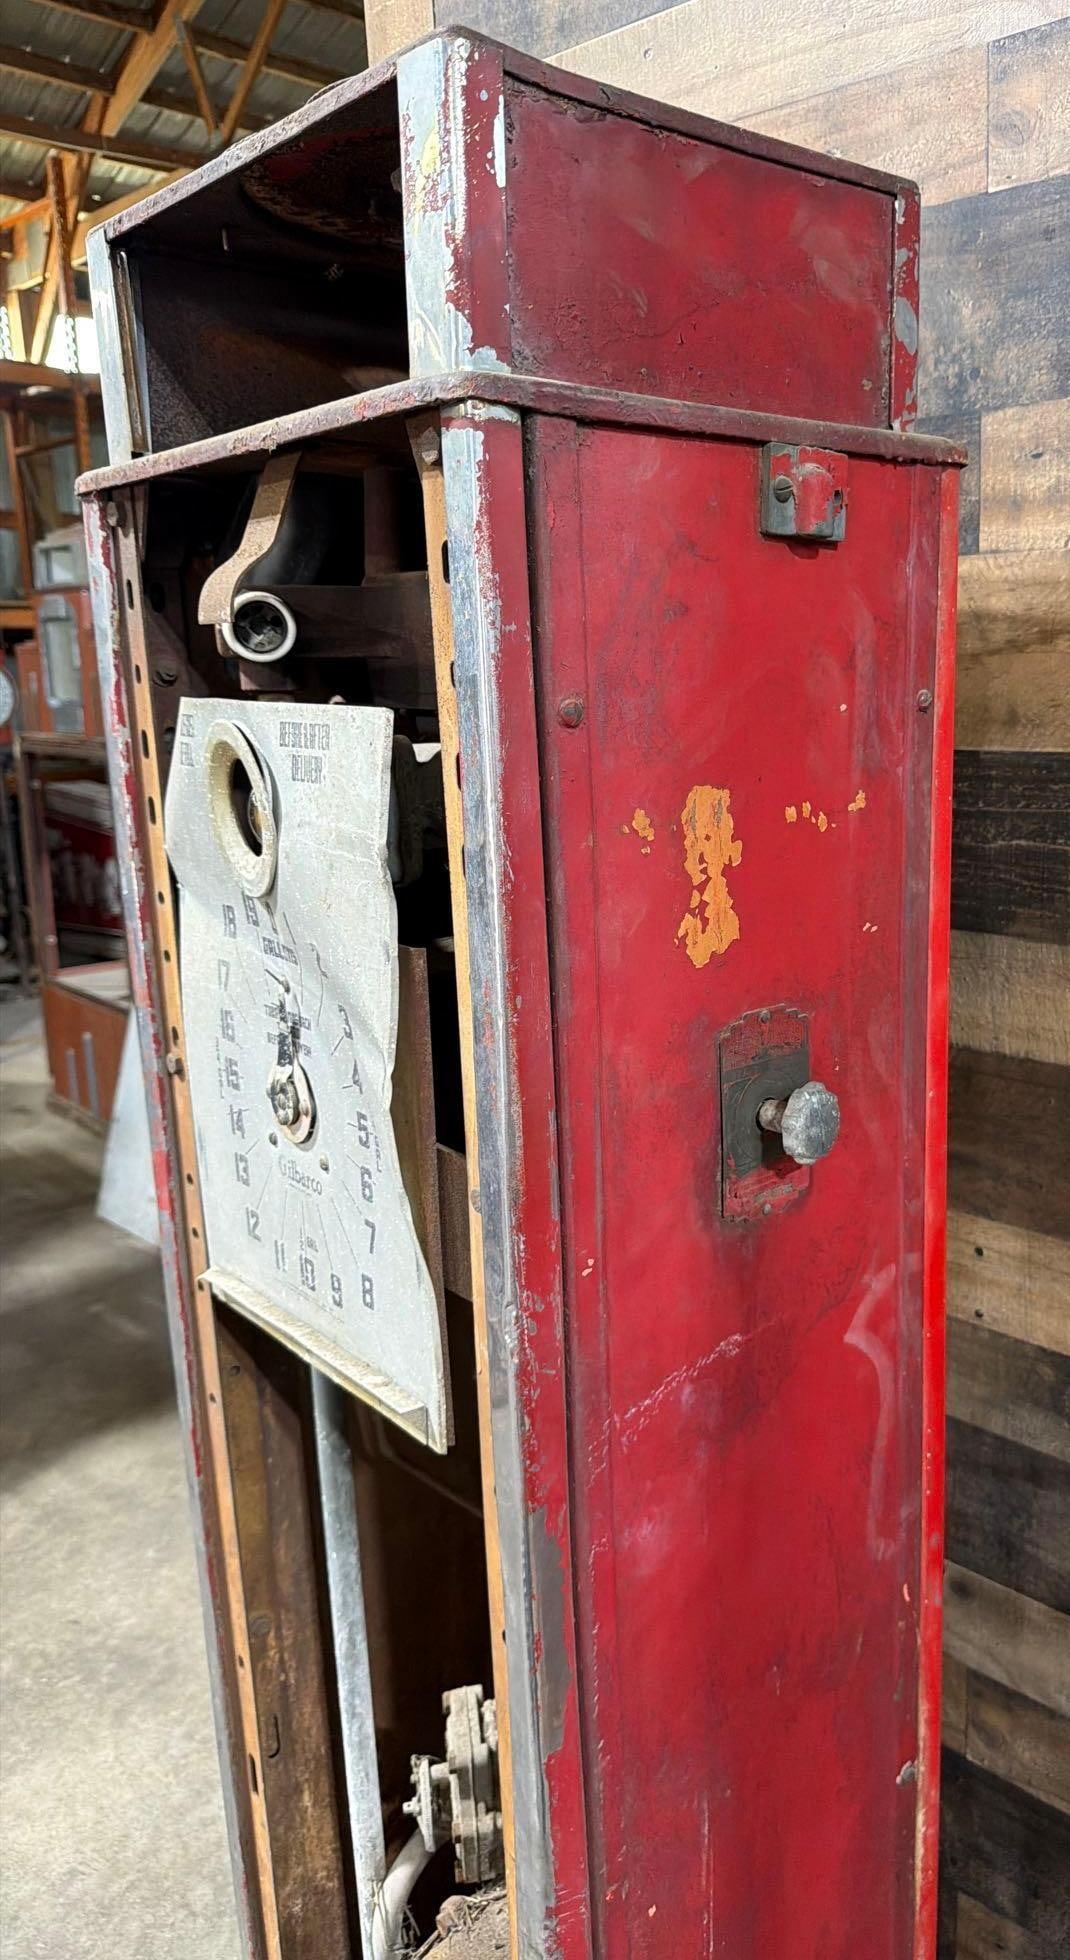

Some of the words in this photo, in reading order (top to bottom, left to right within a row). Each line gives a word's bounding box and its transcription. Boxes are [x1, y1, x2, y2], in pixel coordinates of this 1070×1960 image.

[356, 1111, 370, 1149] 5
[234, 1152, 250, 1187] 13
[360, 1165, 374, 1203] 6
[245, 1206, 261, 1242] 12
[364, 1218, 376, 1254] 7
[330, 1272, 343, 1309] 9
[361, 1272, 374, 1311] 8
